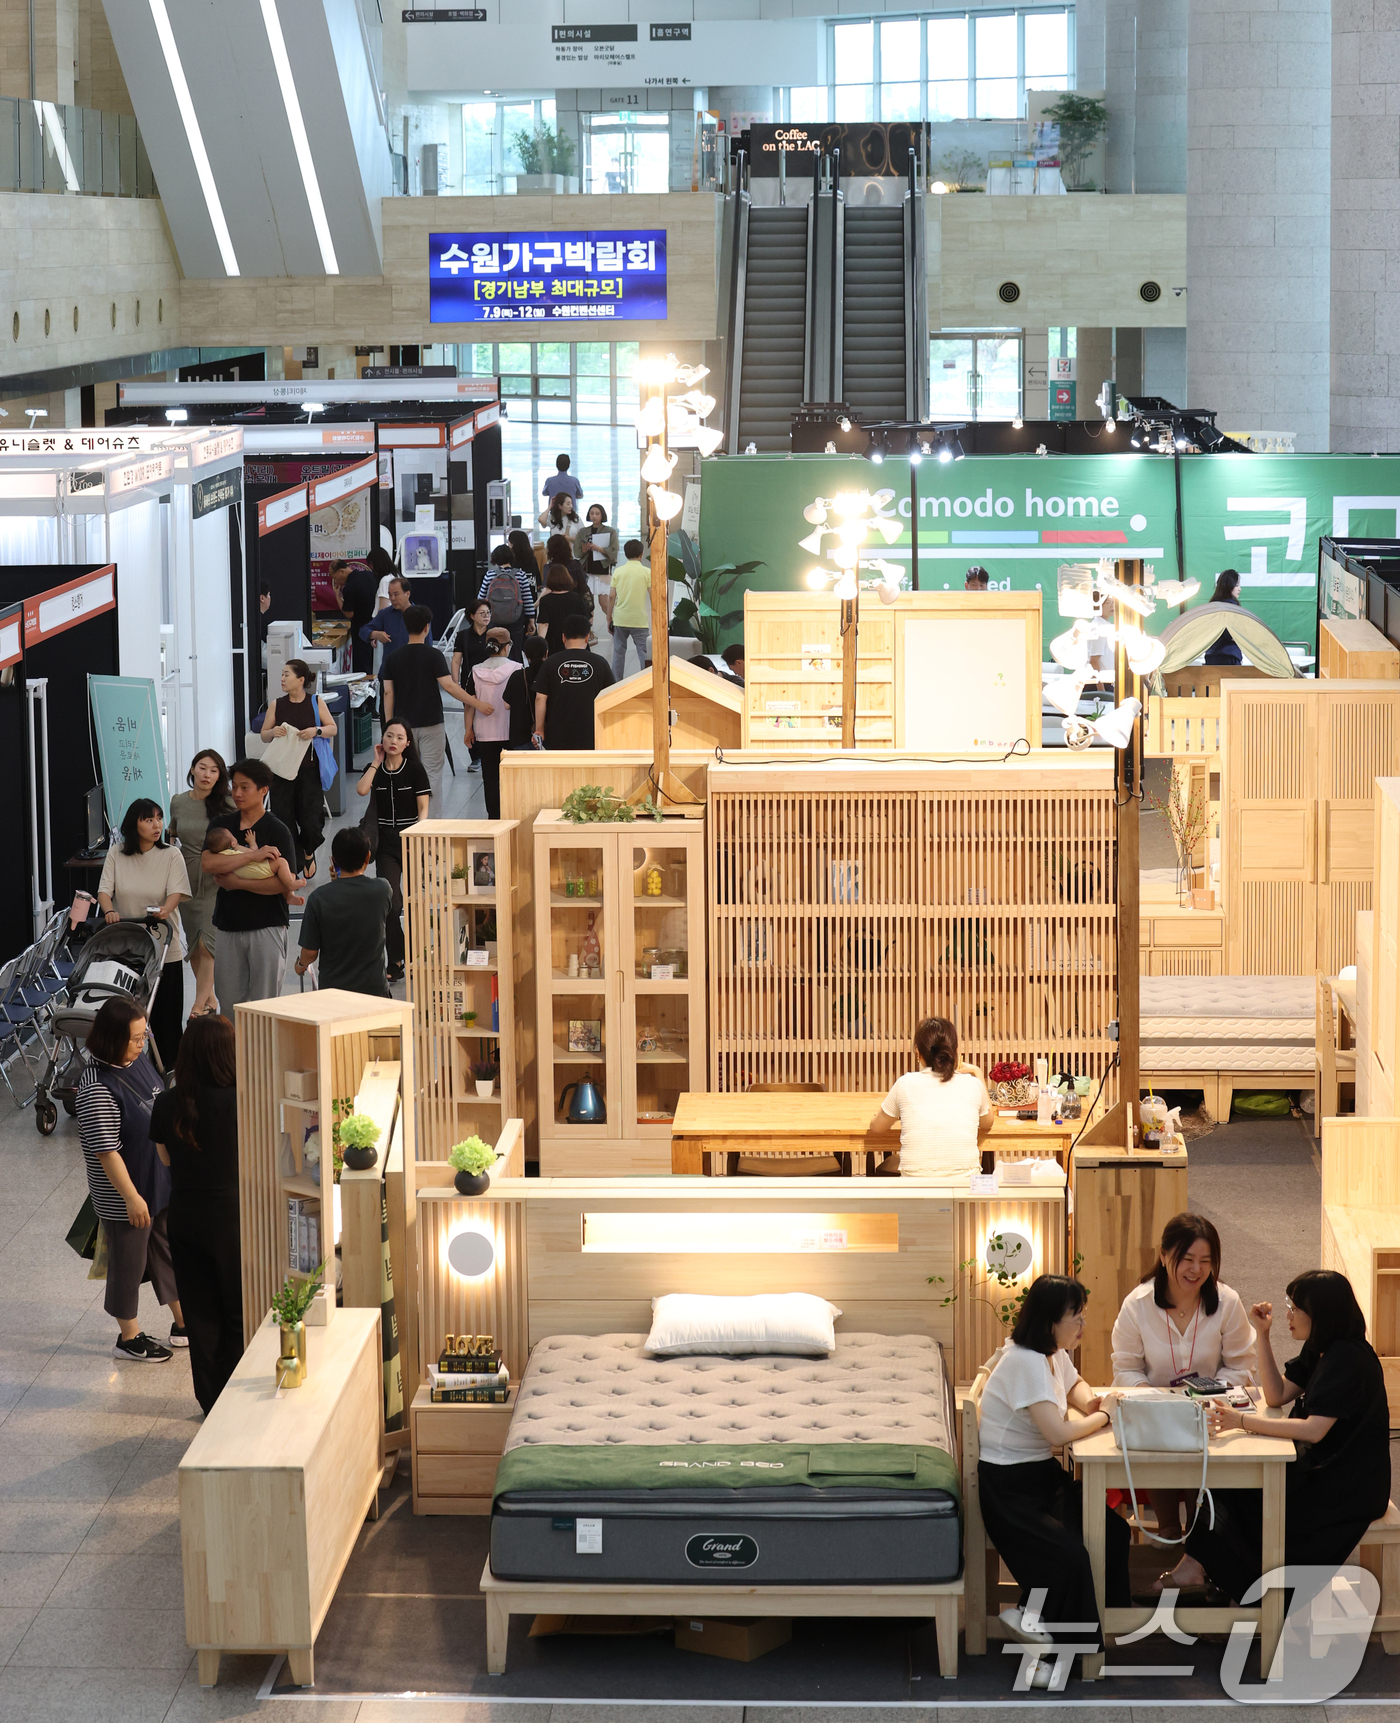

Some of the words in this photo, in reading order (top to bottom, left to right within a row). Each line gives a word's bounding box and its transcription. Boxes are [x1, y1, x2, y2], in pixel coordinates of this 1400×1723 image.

[559, 29, 591, 39] 편의시설
[656, 27, 689, 37] 흡연구역
[666, 77, 678, 85] 왼쪽
[627, 94, 639, 105] 11
[774, 128, 808, 140] Coffee
[762, 143, 776, 151] on
[778, 140, 795, 151] the
[440, 241, 656, 274] 수원가구박람회
[474, 279, 545, 300] [경기남부
[551, 277, 623, 298] 최대규모]
[64, 439, 74, 451] &
[872, 488, 1014, 518] Comodo
[1025, 488, 1119, 518] home
[445, 1333, 494, 1356] LOVE
[702, 1538, 743, 1551] Grand
